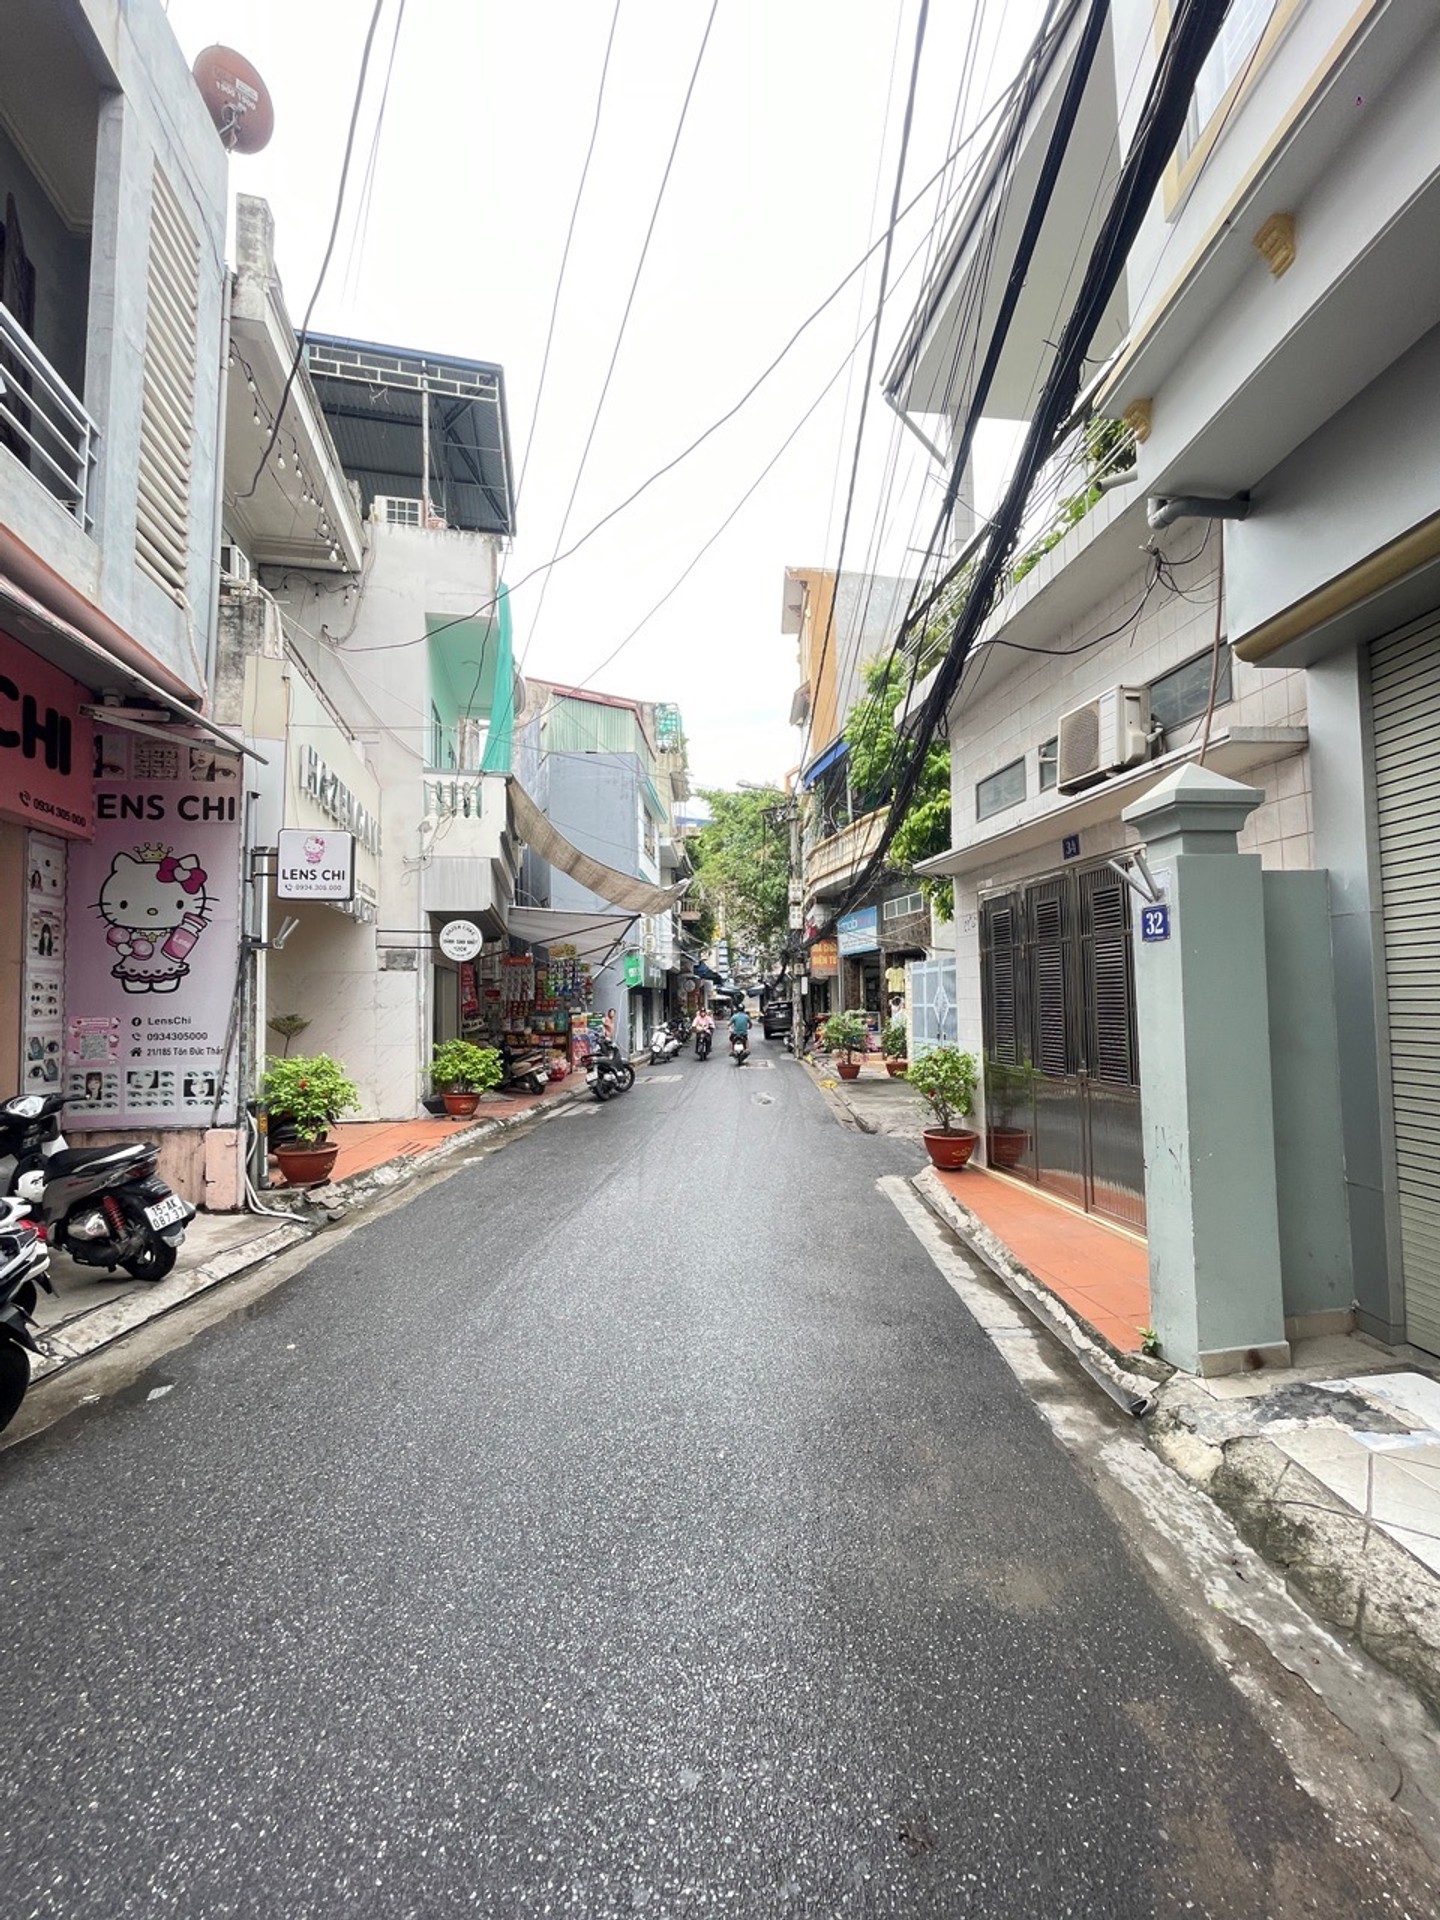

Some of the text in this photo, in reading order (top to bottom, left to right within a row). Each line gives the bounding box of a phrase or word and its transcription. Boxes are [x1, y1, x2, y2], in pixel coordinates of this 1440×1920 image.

[98, 794, 236, 821] ENS CHI
[1065, 839, 1077, 855] 34
[281, 868, 345, 881] LENS CHI
[1145, 911, 1164, 935] 32
[147, 1015, 192, 1026] LensChi
[146, 1031, 208, 1041] 0934305000
[146, 1047, 172, 1056] 21/185
[151, 1200, 177, 1216] 15-AK
